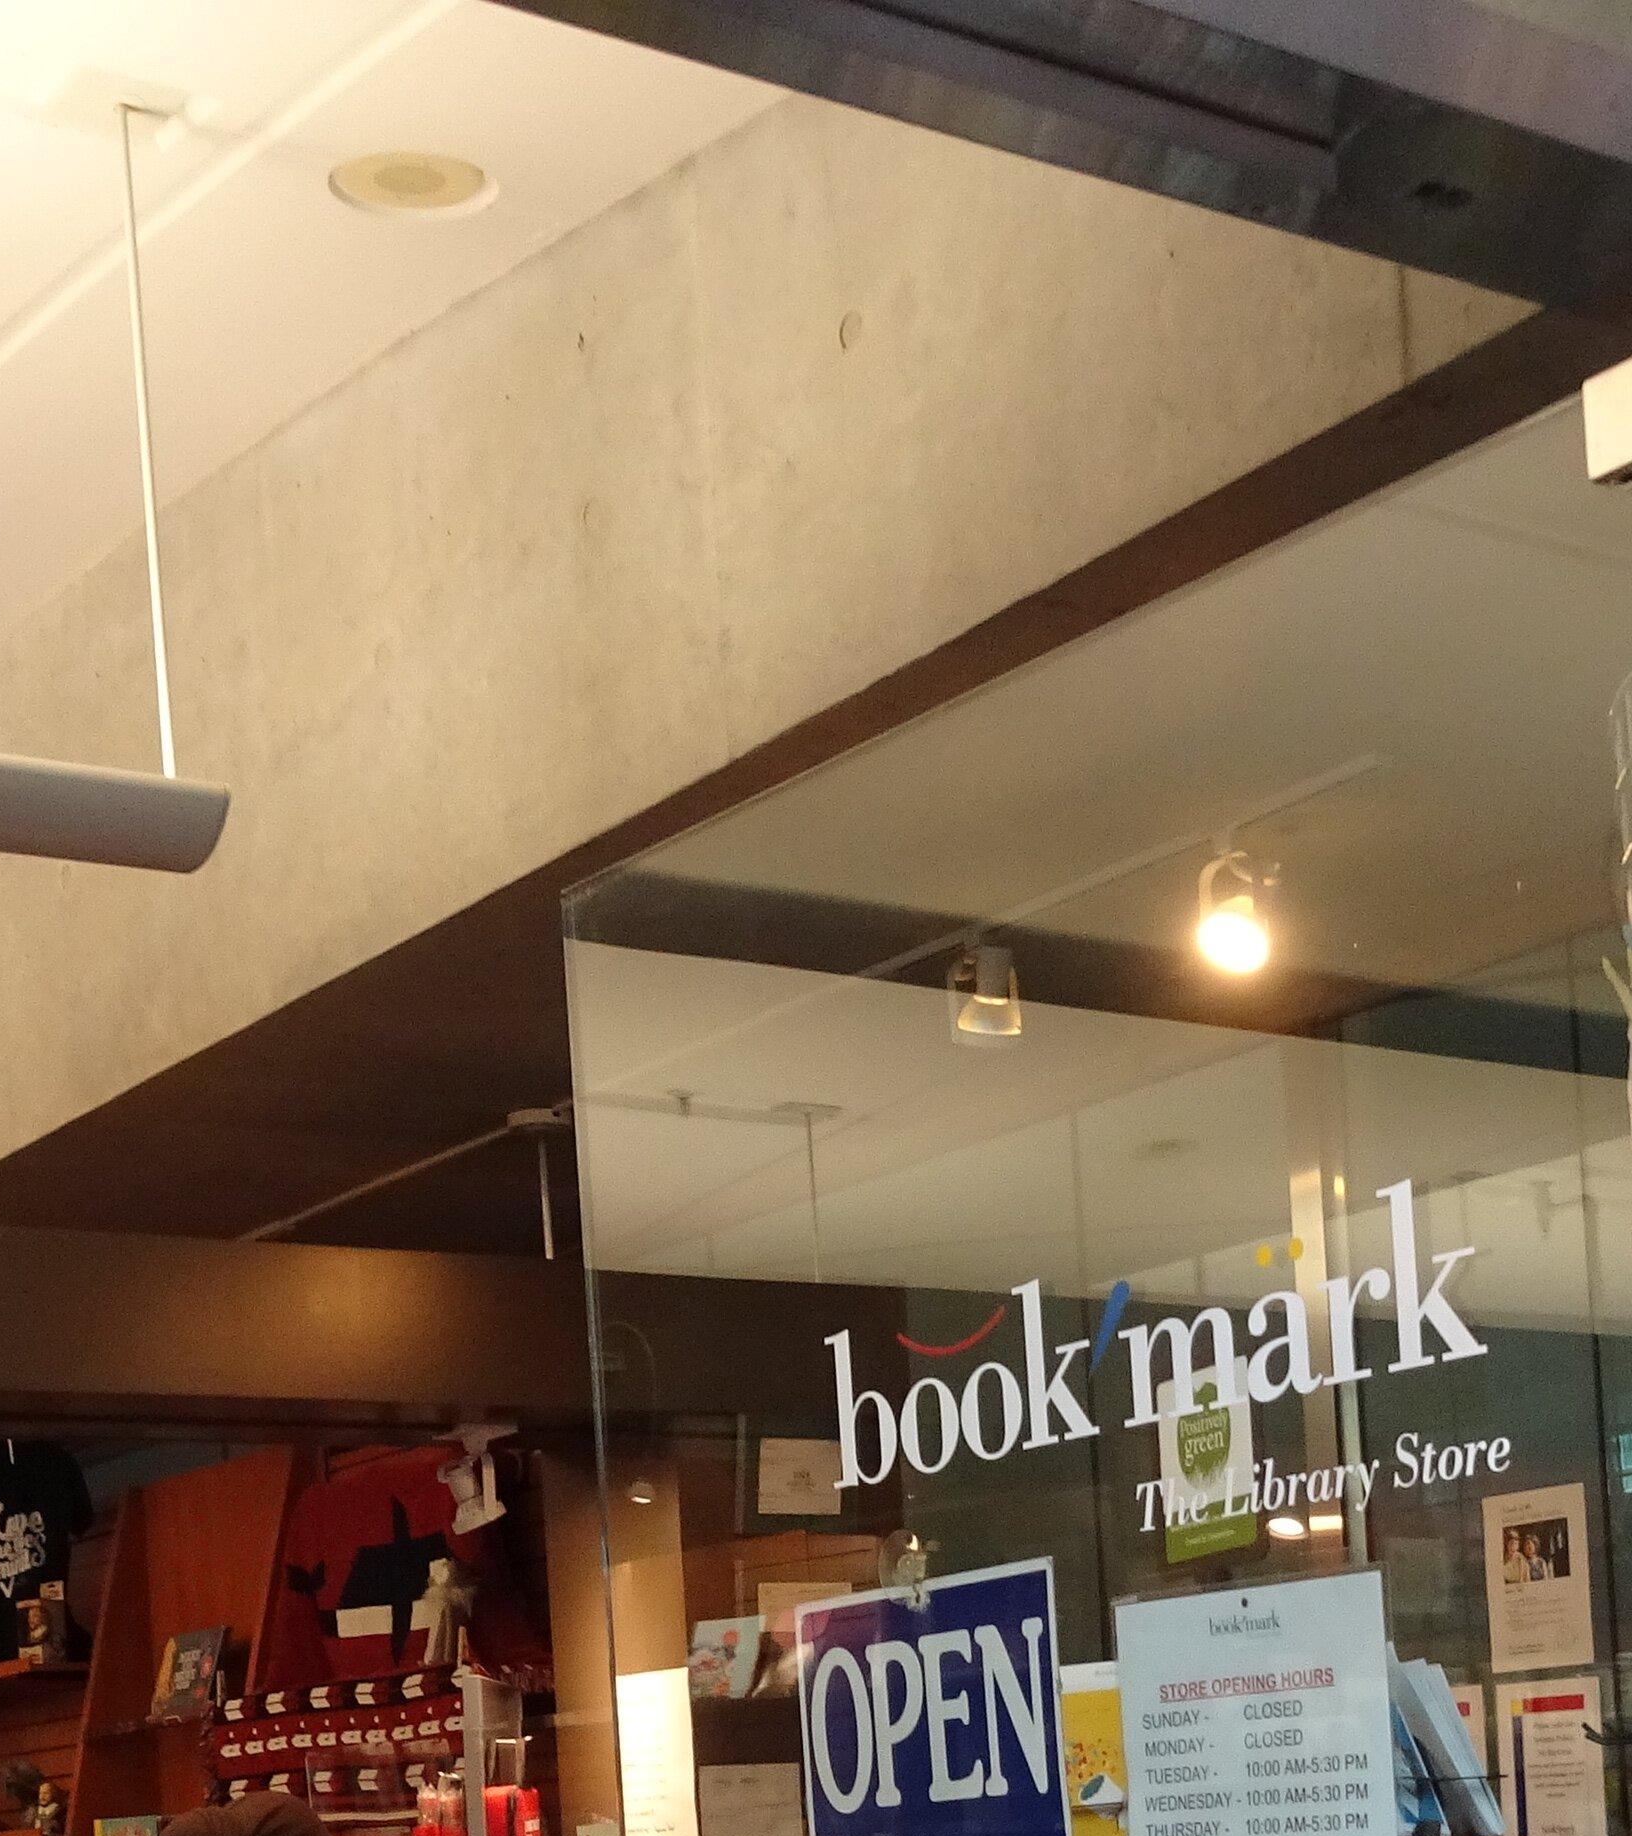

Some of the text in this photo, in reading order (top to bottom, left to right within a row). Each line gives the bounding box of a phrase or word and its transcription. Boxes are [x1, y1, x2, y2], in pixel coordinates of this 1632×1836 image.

[1180, 1410, 1228, 1437] Positively
[1185, 1431, 1224, 1466] green
[1137, 1480, 1207, 1533] The
[1221, 1460, 1378, 1518] Library
[1394, 1429, 1512, 1491] Store
[1159, 1668, 1335, 1700] STORE OPENING HOURS
[811, 1617, 1049, 1814] OPEN
[1142, 1699, 1303, 1730] SUNDAY CLOSED
[1145, 1728, 1303, 1757] MONDAY CLOSED
[1145, 1753, 1368, 1785] TUESDAY 10:00 AM-5:30 PM
[1145, 1783, 1369, 1812] WEDNESDAY 10:00 AM-5:30 PM
[1246, 1818, 1280, 1835] 10:00
[1284, 1814, 1341, 1833] AM-5:30
[1345, 1813, 1369, 1829] PM
